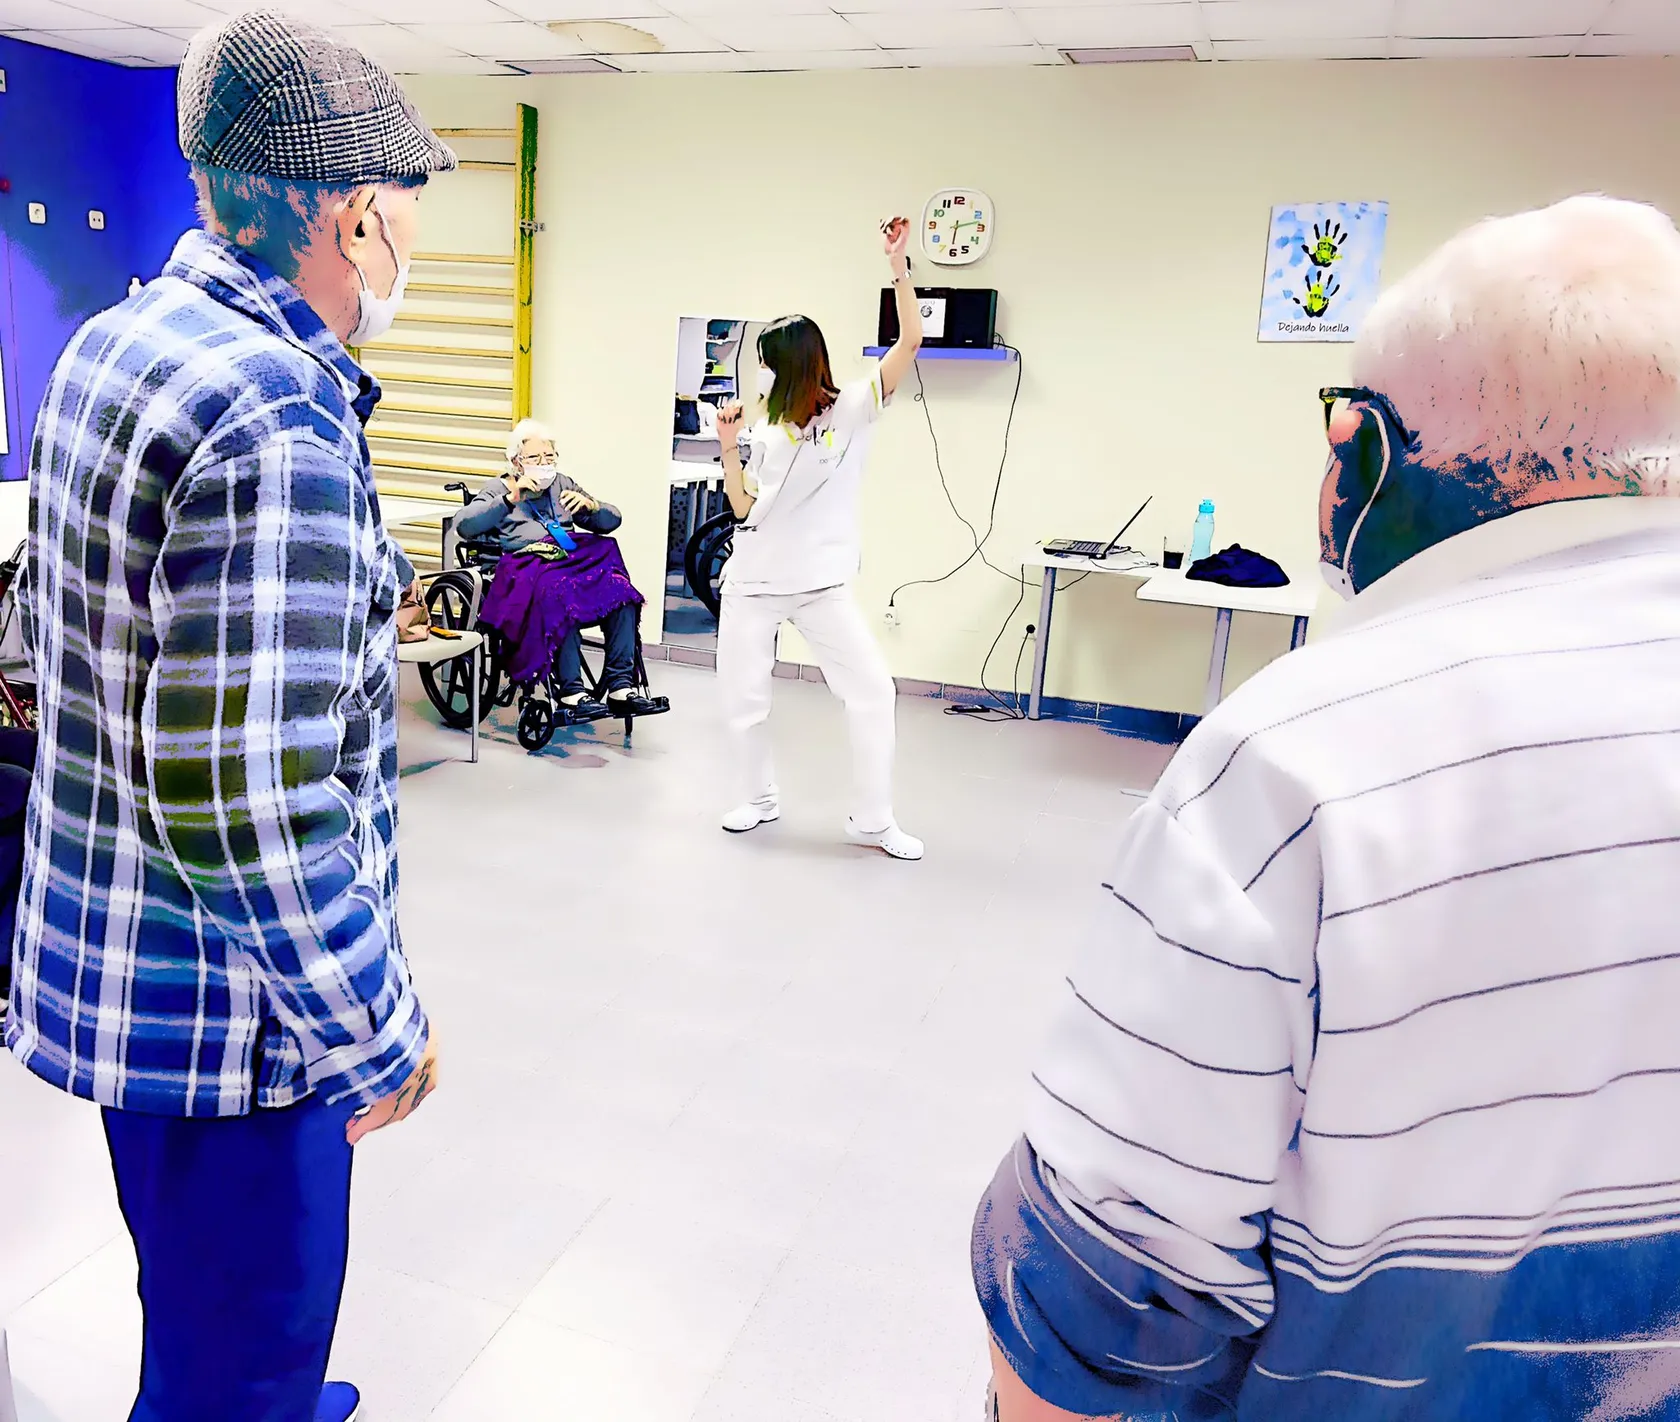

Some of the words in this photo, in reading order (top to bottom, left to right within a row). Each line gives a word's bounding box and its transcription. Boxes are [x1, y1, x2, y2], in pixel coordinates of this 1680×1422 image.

[942, 199, 951, 208] 11
[954, 196, 965, 205] 12
[933, 209, 945, 218] 10
[974, 210, 982, 219] 2
[928, 221, 937, 230] 9
[977, 223, 985, 232] 3
[932, 234, 940, 243] 8
[970, 236, 979, 245] 4
[939, 244, 947, 253] 7
[949, 248, 958, 257] 6
[960, 245, 970, 254] 5
[1278, 322, 1316, 333] Dejando
[1318, 323, 1350, 333] huella
